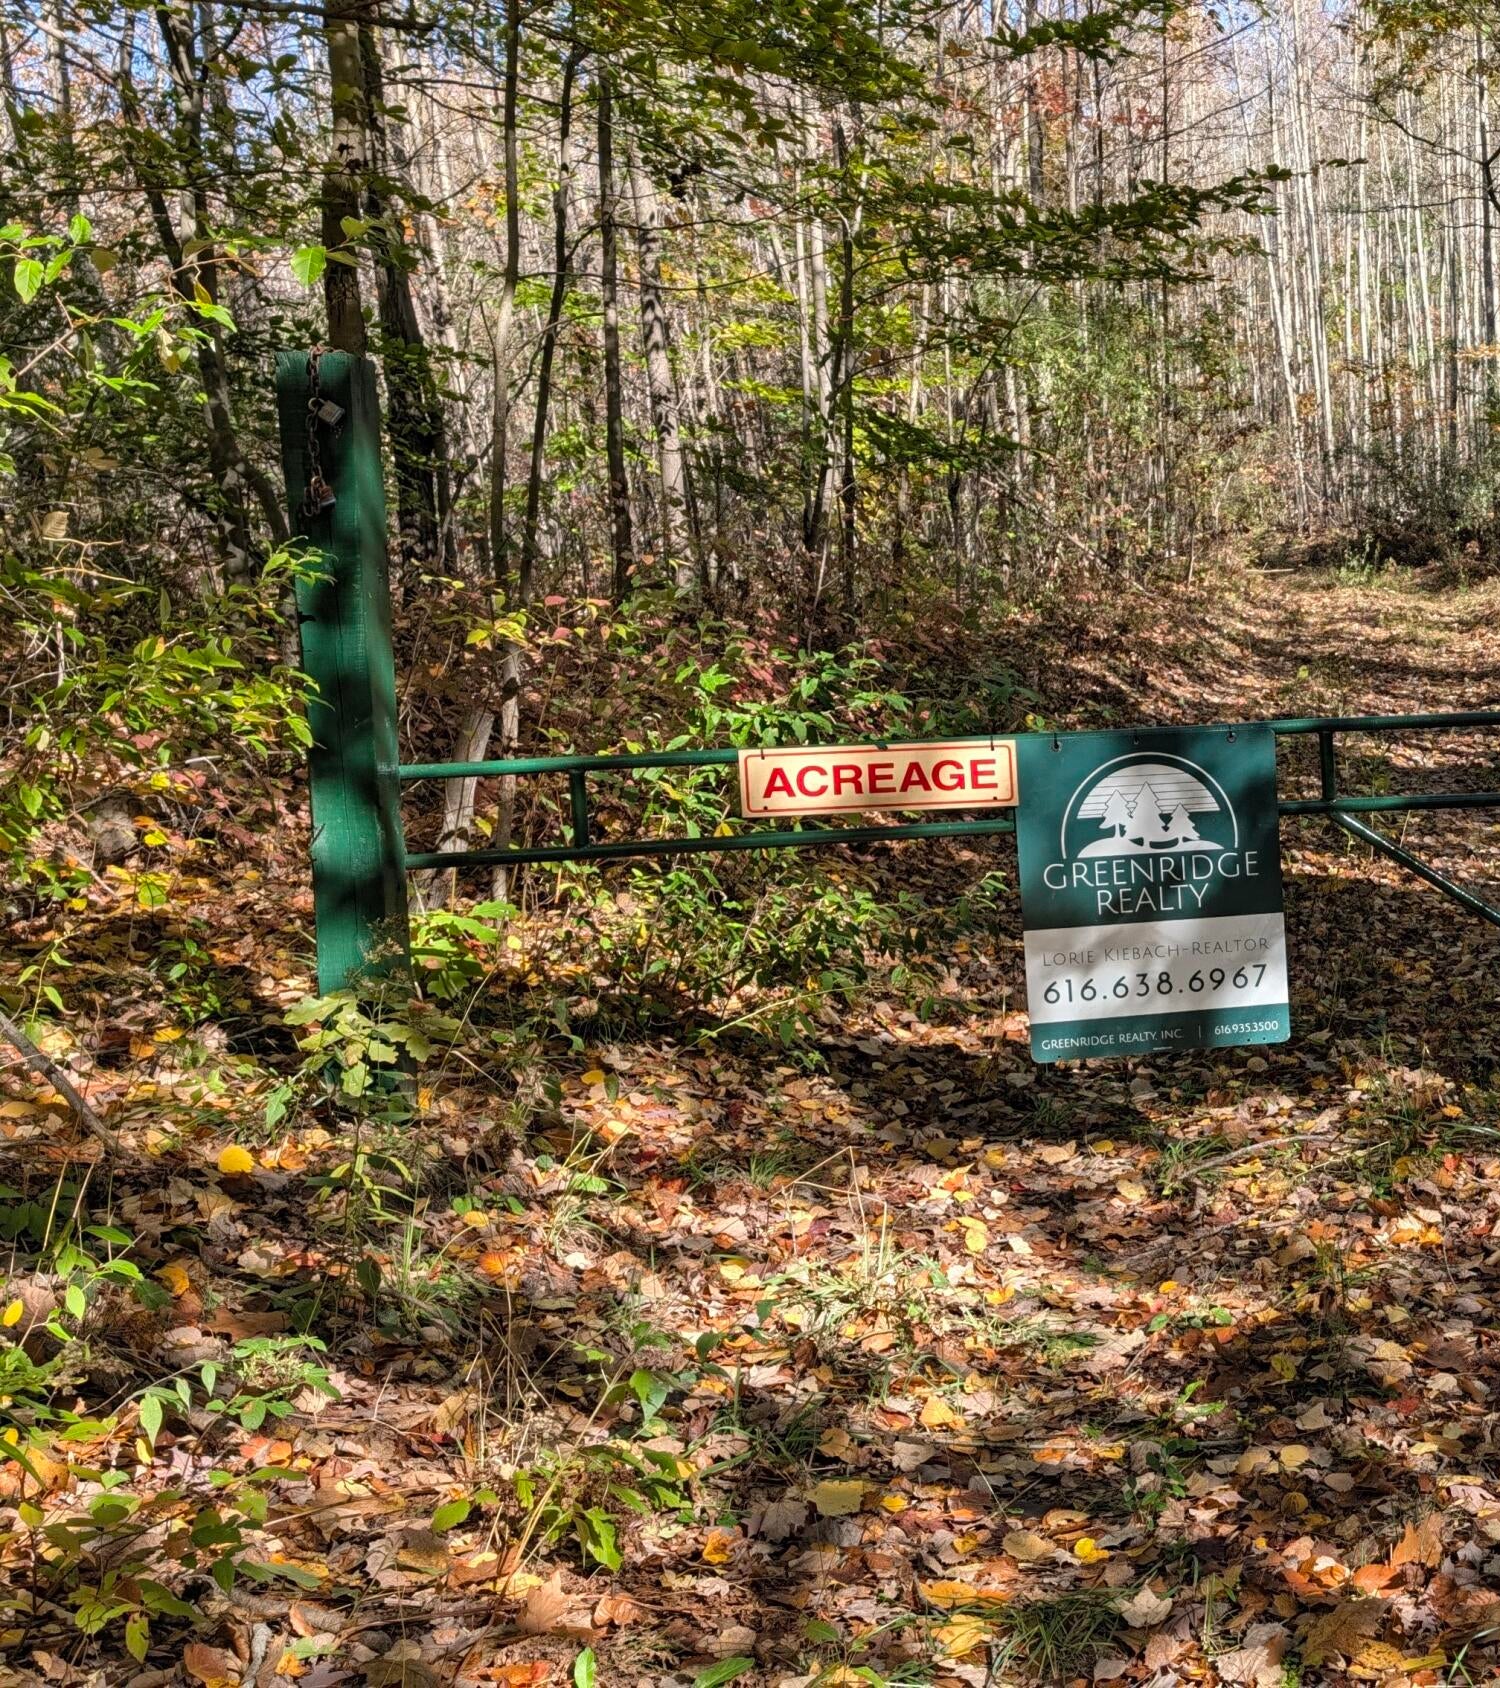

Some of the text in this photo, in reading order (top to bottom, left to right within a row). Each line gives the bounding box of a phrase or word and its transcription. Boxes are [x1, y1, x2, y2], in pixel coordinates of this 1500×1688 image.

[762, 758, 998, 799] ACREAGE
[1043, 850, 1260, 891] GREENRIDGE
[1097, 882, 1210, 916] REALTY
[1043, 950, 1097, 967] LORIE
[1044, 963, 1268, 1004] 616.638.6967
[1041, 1034, 1116, 1051] GREENRIDGE
